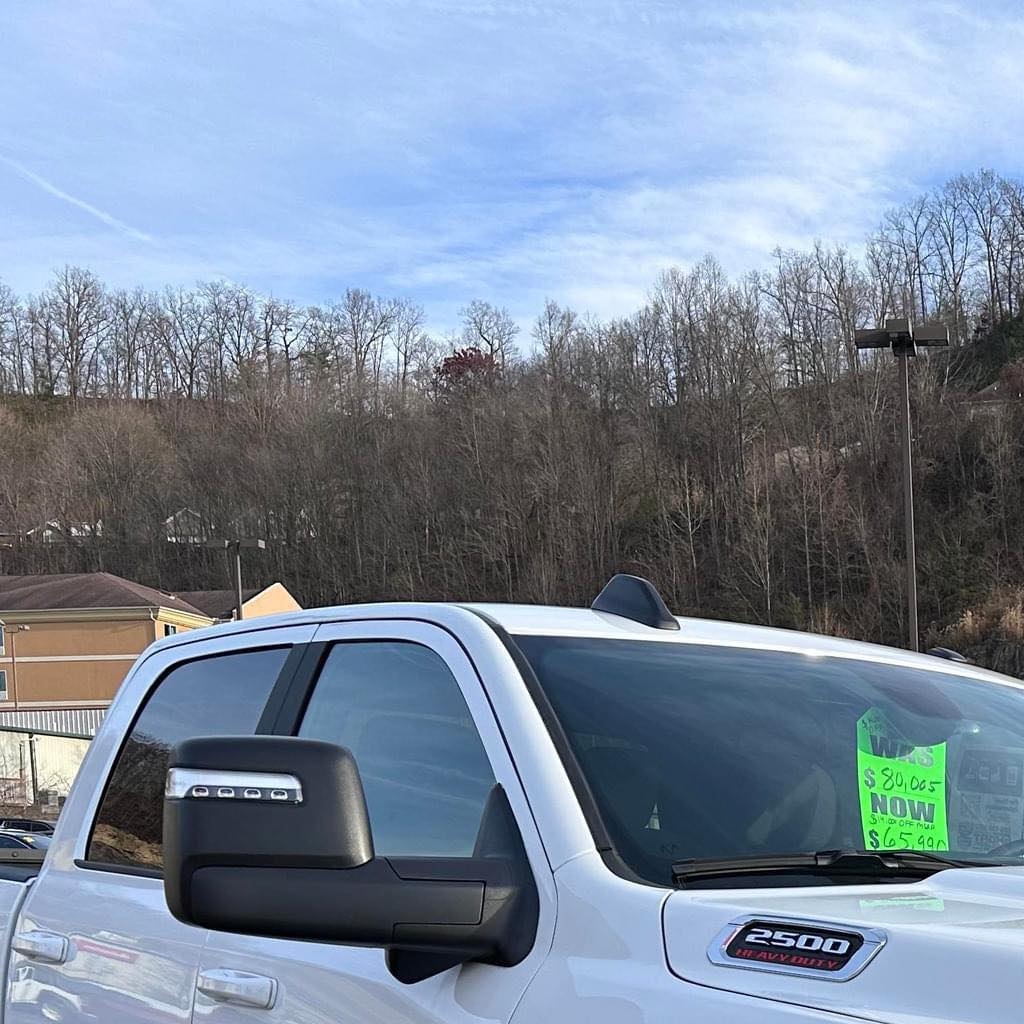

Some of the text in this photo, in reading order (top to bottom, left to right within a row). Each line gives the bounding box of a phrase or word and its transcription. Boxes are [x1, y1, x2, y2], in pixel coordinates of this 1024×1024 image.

[869, 735, 934, 768] WAS
[870, 792, 936, 824] NOW
[744, 928, 850, 955] 2500
[735, 949, 841, 969] HEAVY DUTY
